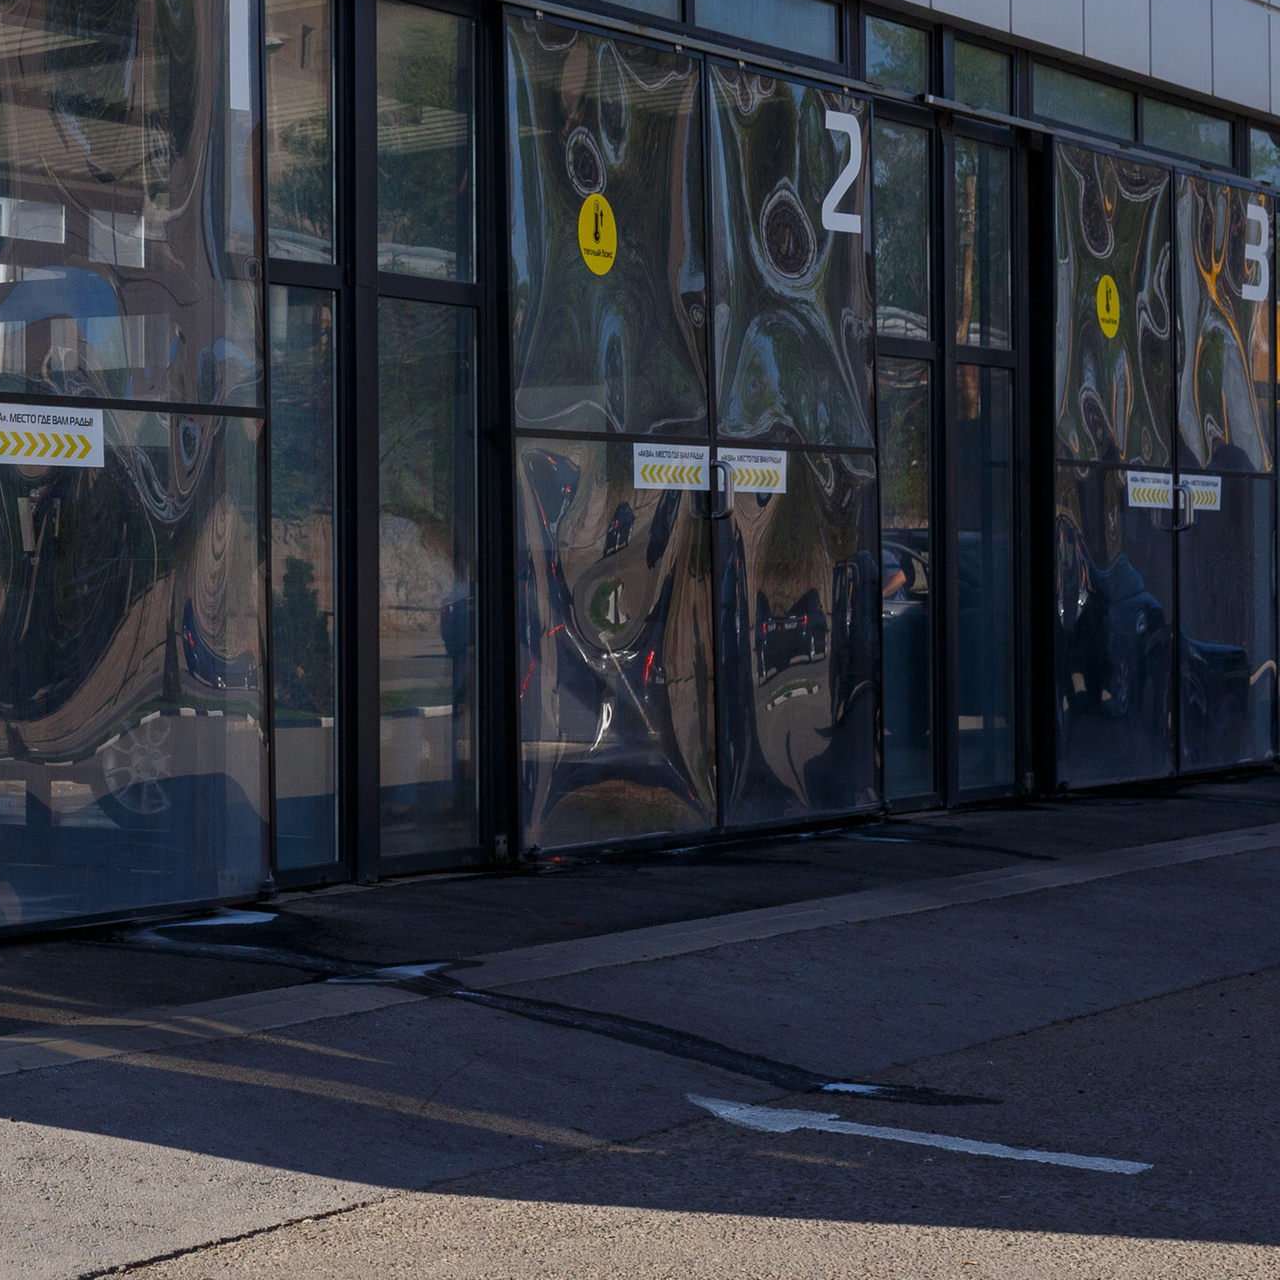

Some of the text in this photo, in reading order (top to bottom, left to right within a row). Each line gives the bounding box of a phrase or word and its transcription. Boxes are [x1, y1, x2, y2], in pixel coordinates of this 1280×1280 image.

[821, 110, 862, 234] 2
[1241, 203, 1270, 302] 3
[9, 413, 37, 424] МЕСТО
[37, 414, 51, 425] ГДЕ
[52, 415, 69, 426] ВАМ
